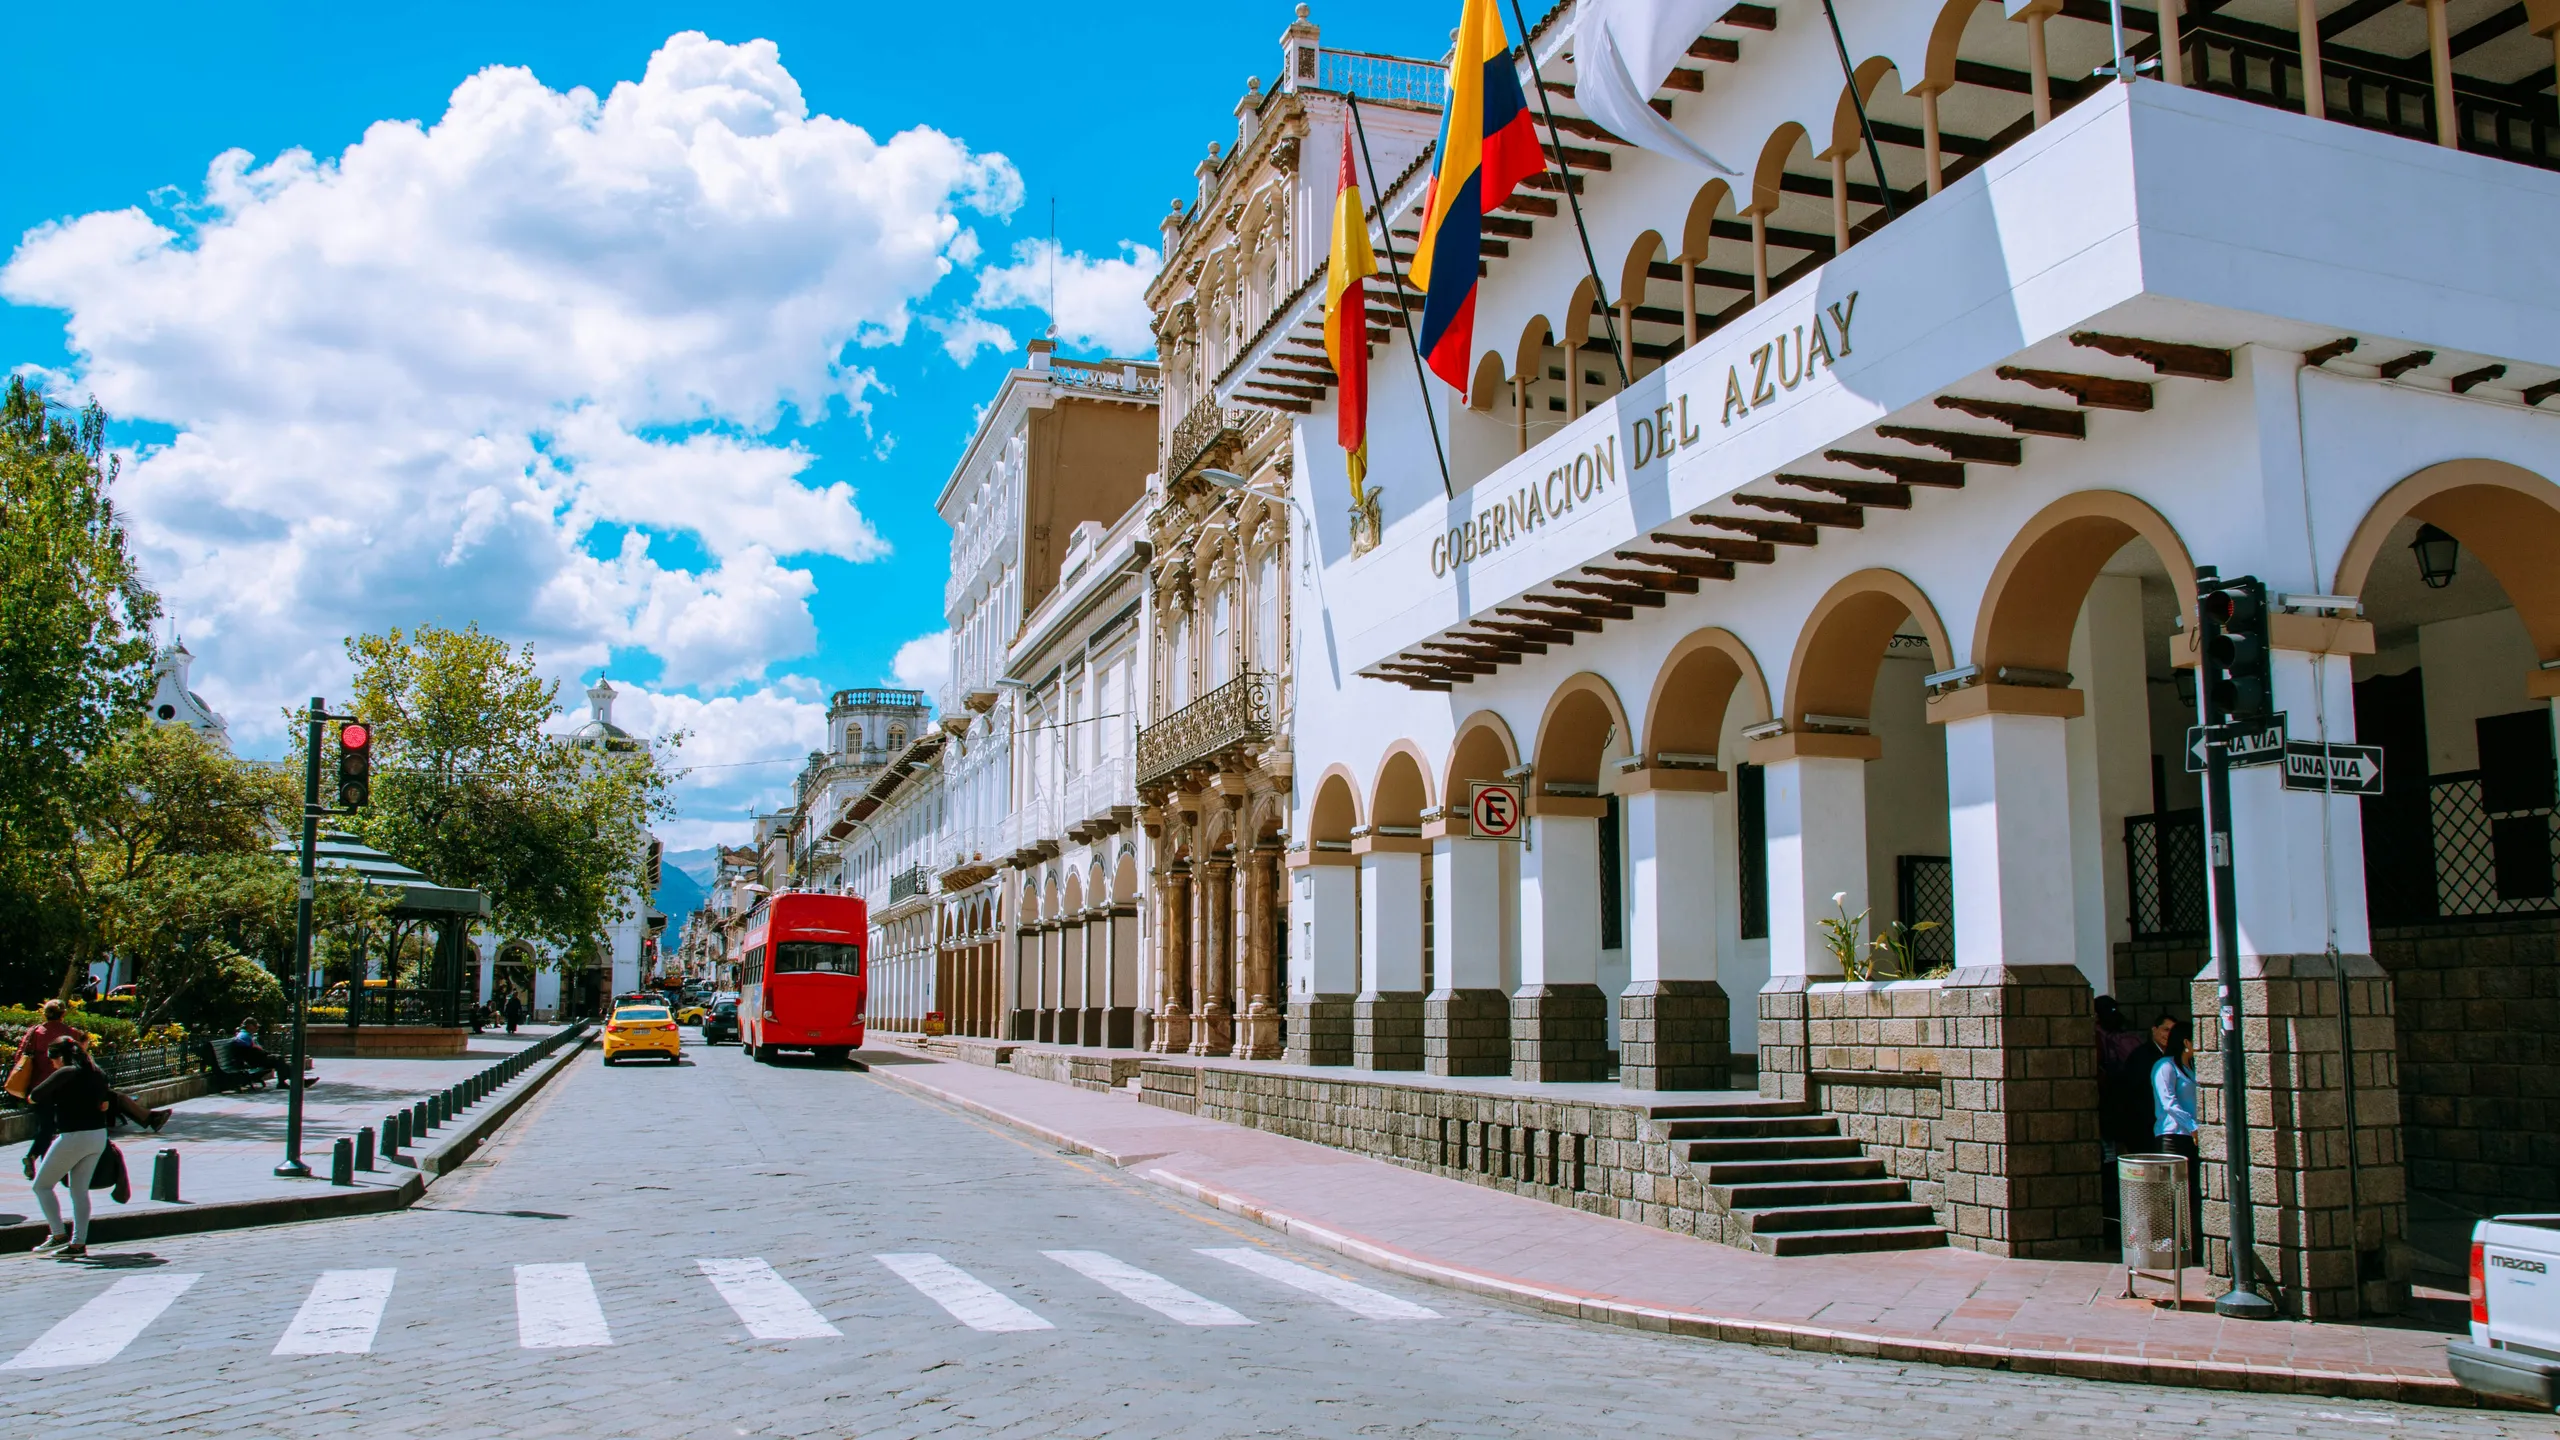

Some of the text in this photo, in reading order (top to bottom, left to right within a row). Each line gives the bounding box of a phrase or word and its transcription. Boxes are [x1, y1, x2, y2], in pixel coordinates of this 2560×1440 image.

[1431, 291, 1858, 577] GOBERNACION DEL AZUAY
[2250, 729, 2279, 750] VIA
[2291, 756, 2361, 777] UNA VIA
[1486, 796, 1507, 826] E
